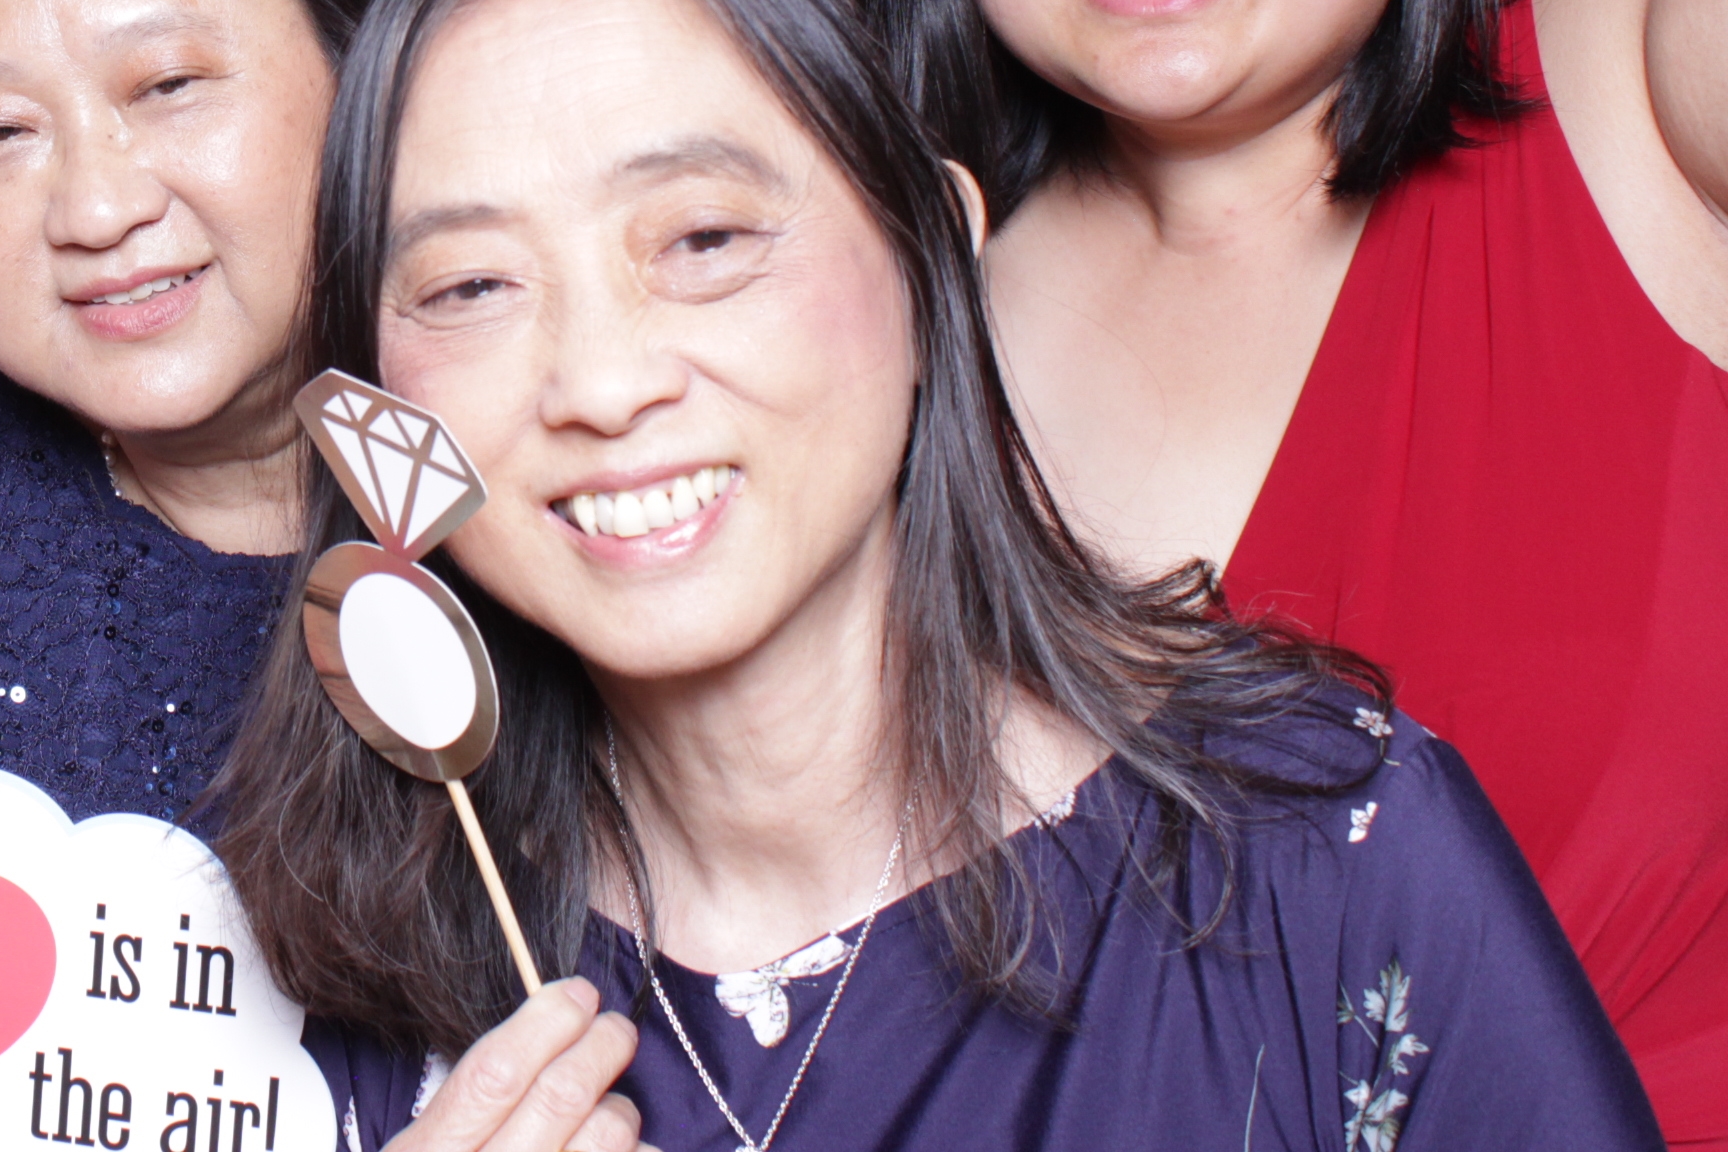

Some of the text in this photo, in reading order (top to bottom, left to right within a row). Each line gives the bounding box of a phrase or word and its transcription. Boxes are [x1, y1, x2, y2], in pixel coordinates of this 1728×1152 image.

[86, 903, 237, 1016] is in
[29, 1047, 132, 1151] the
